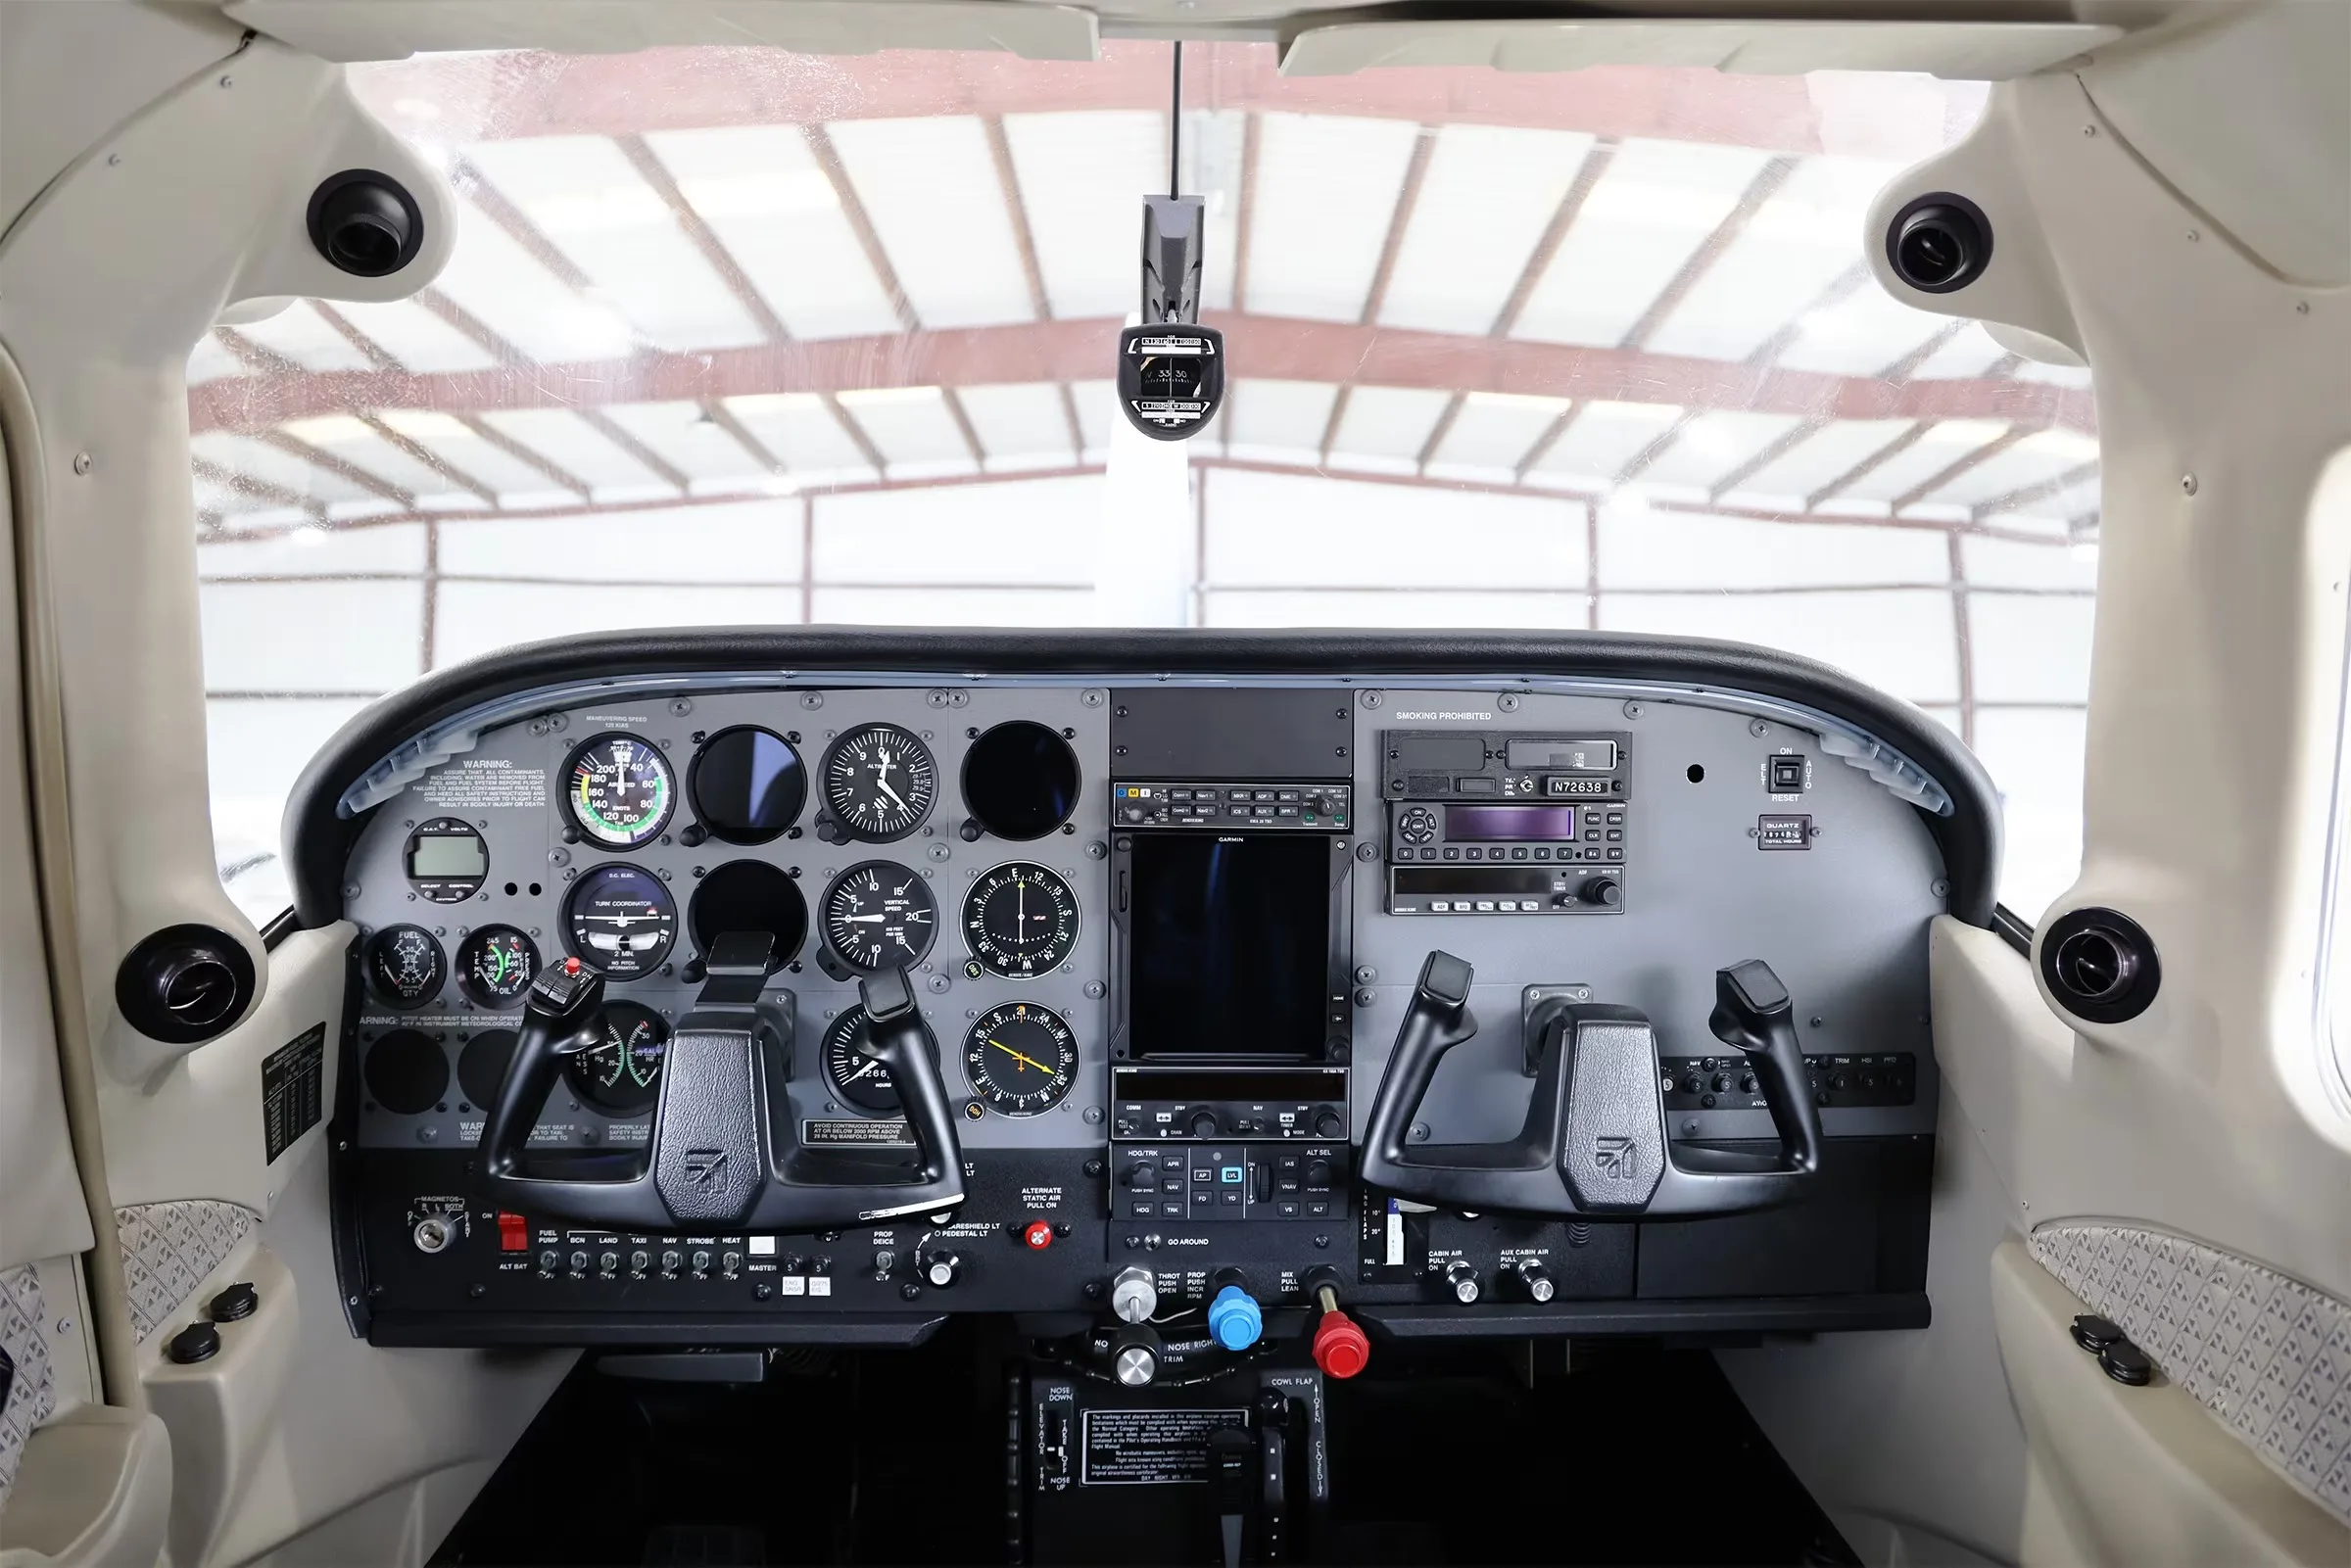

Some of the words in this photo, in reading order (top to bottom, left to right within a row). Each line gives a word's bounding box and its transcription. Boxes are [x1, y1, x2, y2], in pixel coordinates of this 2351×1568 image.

[1396, 712, 1437, 720] SMOKING
[1440, 712, 1491, 720] PROHIBITED
[860, 752, 867, 761] 9
[596, 765, 615, 773] 200
[630, 763, 643, 771] 40
[847, 767, 854, 776] 8
[1555, 782, 1601, 792] N72638
[588, 788, 604, 796] 160
[847, 788, 853, 796] 7
[909, 793, 916, 801] 3
[859, 803, 866, 812] 6
[603, 812, 619, 820] 120
[878, 810, 884, 818] 5
[1012, 868, 1018, 877] E
[869, 882, 879, 891] 10
[894, 887, 903, 896] 15
[905, 913, 918, 921] 20
[872, 945, 881, 953] 10
[852, 1056, 859, 1065] 5
[1168, 1342, 1190, 1351] NOSE
